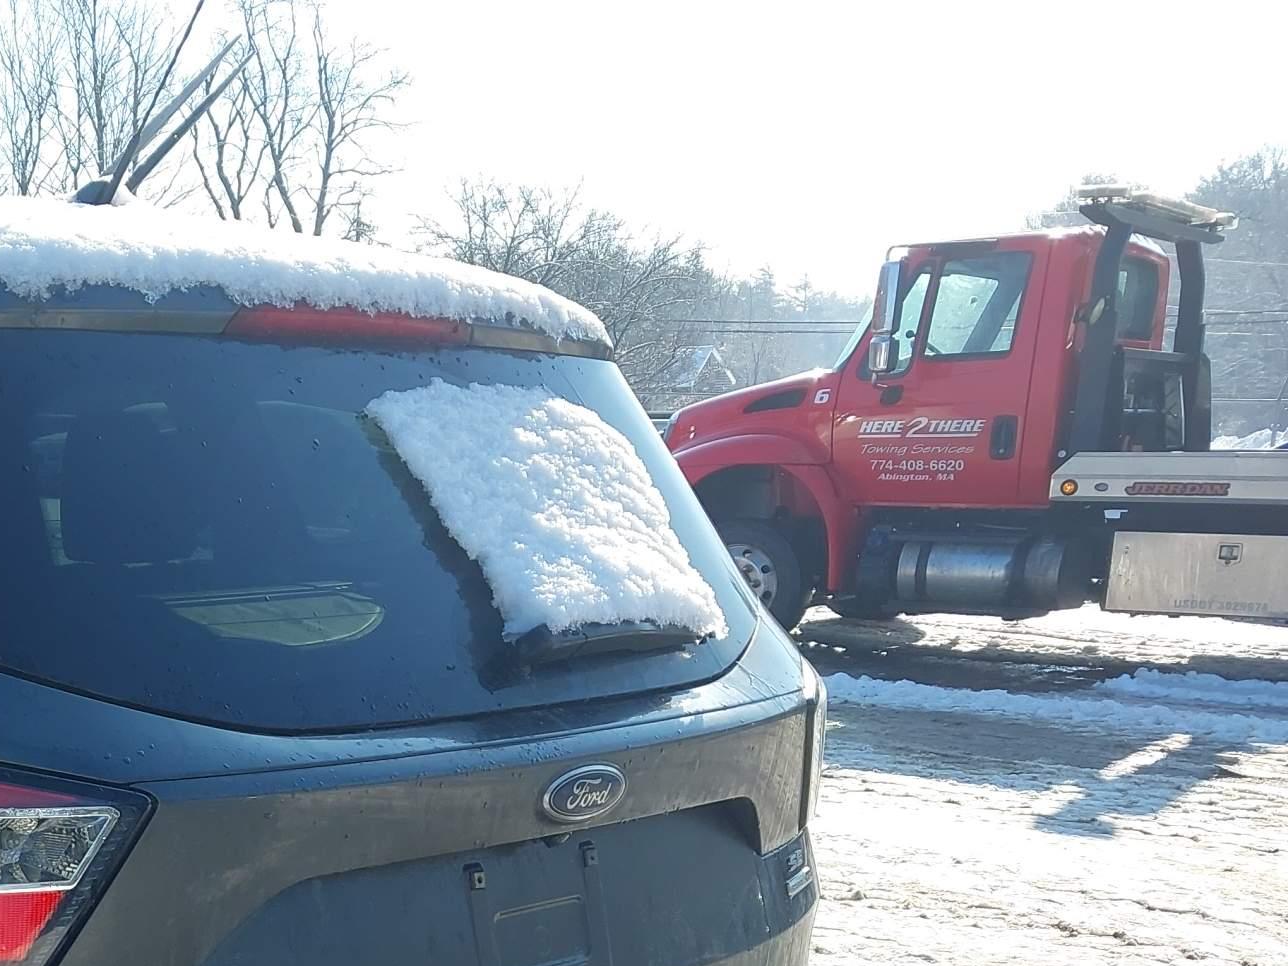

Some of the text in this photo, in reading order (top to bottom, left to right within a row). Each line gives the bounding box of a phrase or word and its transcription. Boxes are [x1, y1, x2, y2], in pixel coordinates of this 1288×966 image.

[814, 388, 832, 404] 6
[859, 416, 987, 437] HERE 2 THERE
[861, 443, 975, 456] Towing Services
[870, 459, 965, 471] 774-408-6620
[936, 472, 955, 481] MA
[566, 777, 612, 810] Ford
